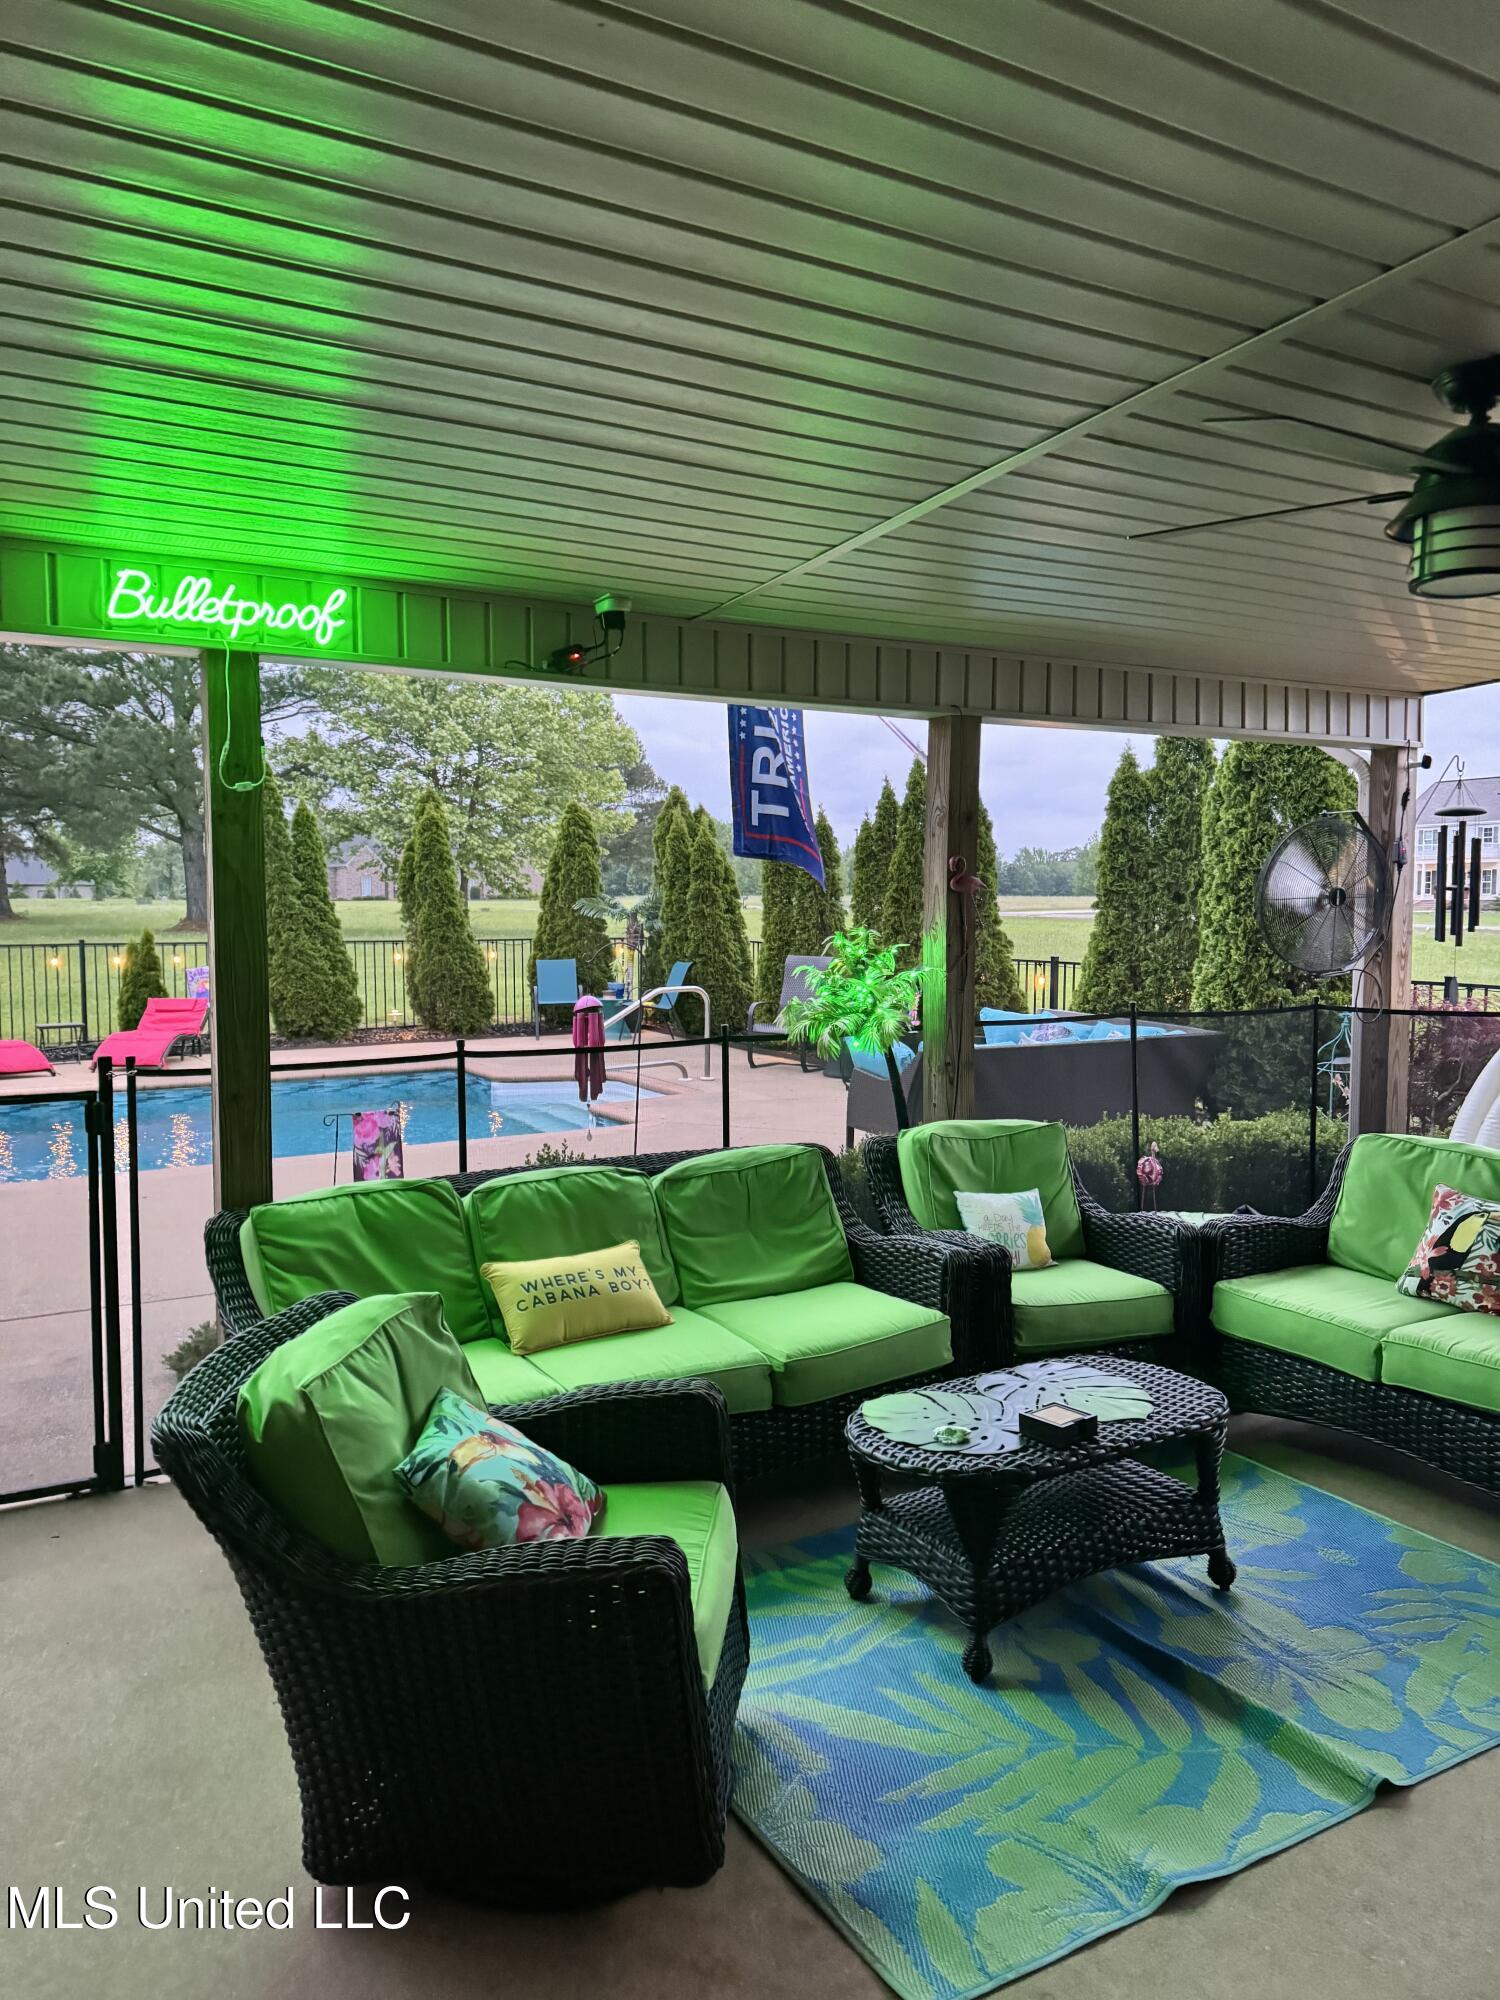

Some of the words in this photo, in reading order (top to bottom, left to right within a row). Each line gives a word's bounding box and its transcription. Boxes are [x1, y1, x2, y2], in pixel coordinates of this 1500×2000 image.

[107, 568, 347, 645] Bulletproof
[516, 1284, 600, 1312] CABANA
[608, 1278, 651, 1294] BOY?
[520, 1269, 605, 1294] WHERE'S
[613, 1265, 637, 1278] MY
